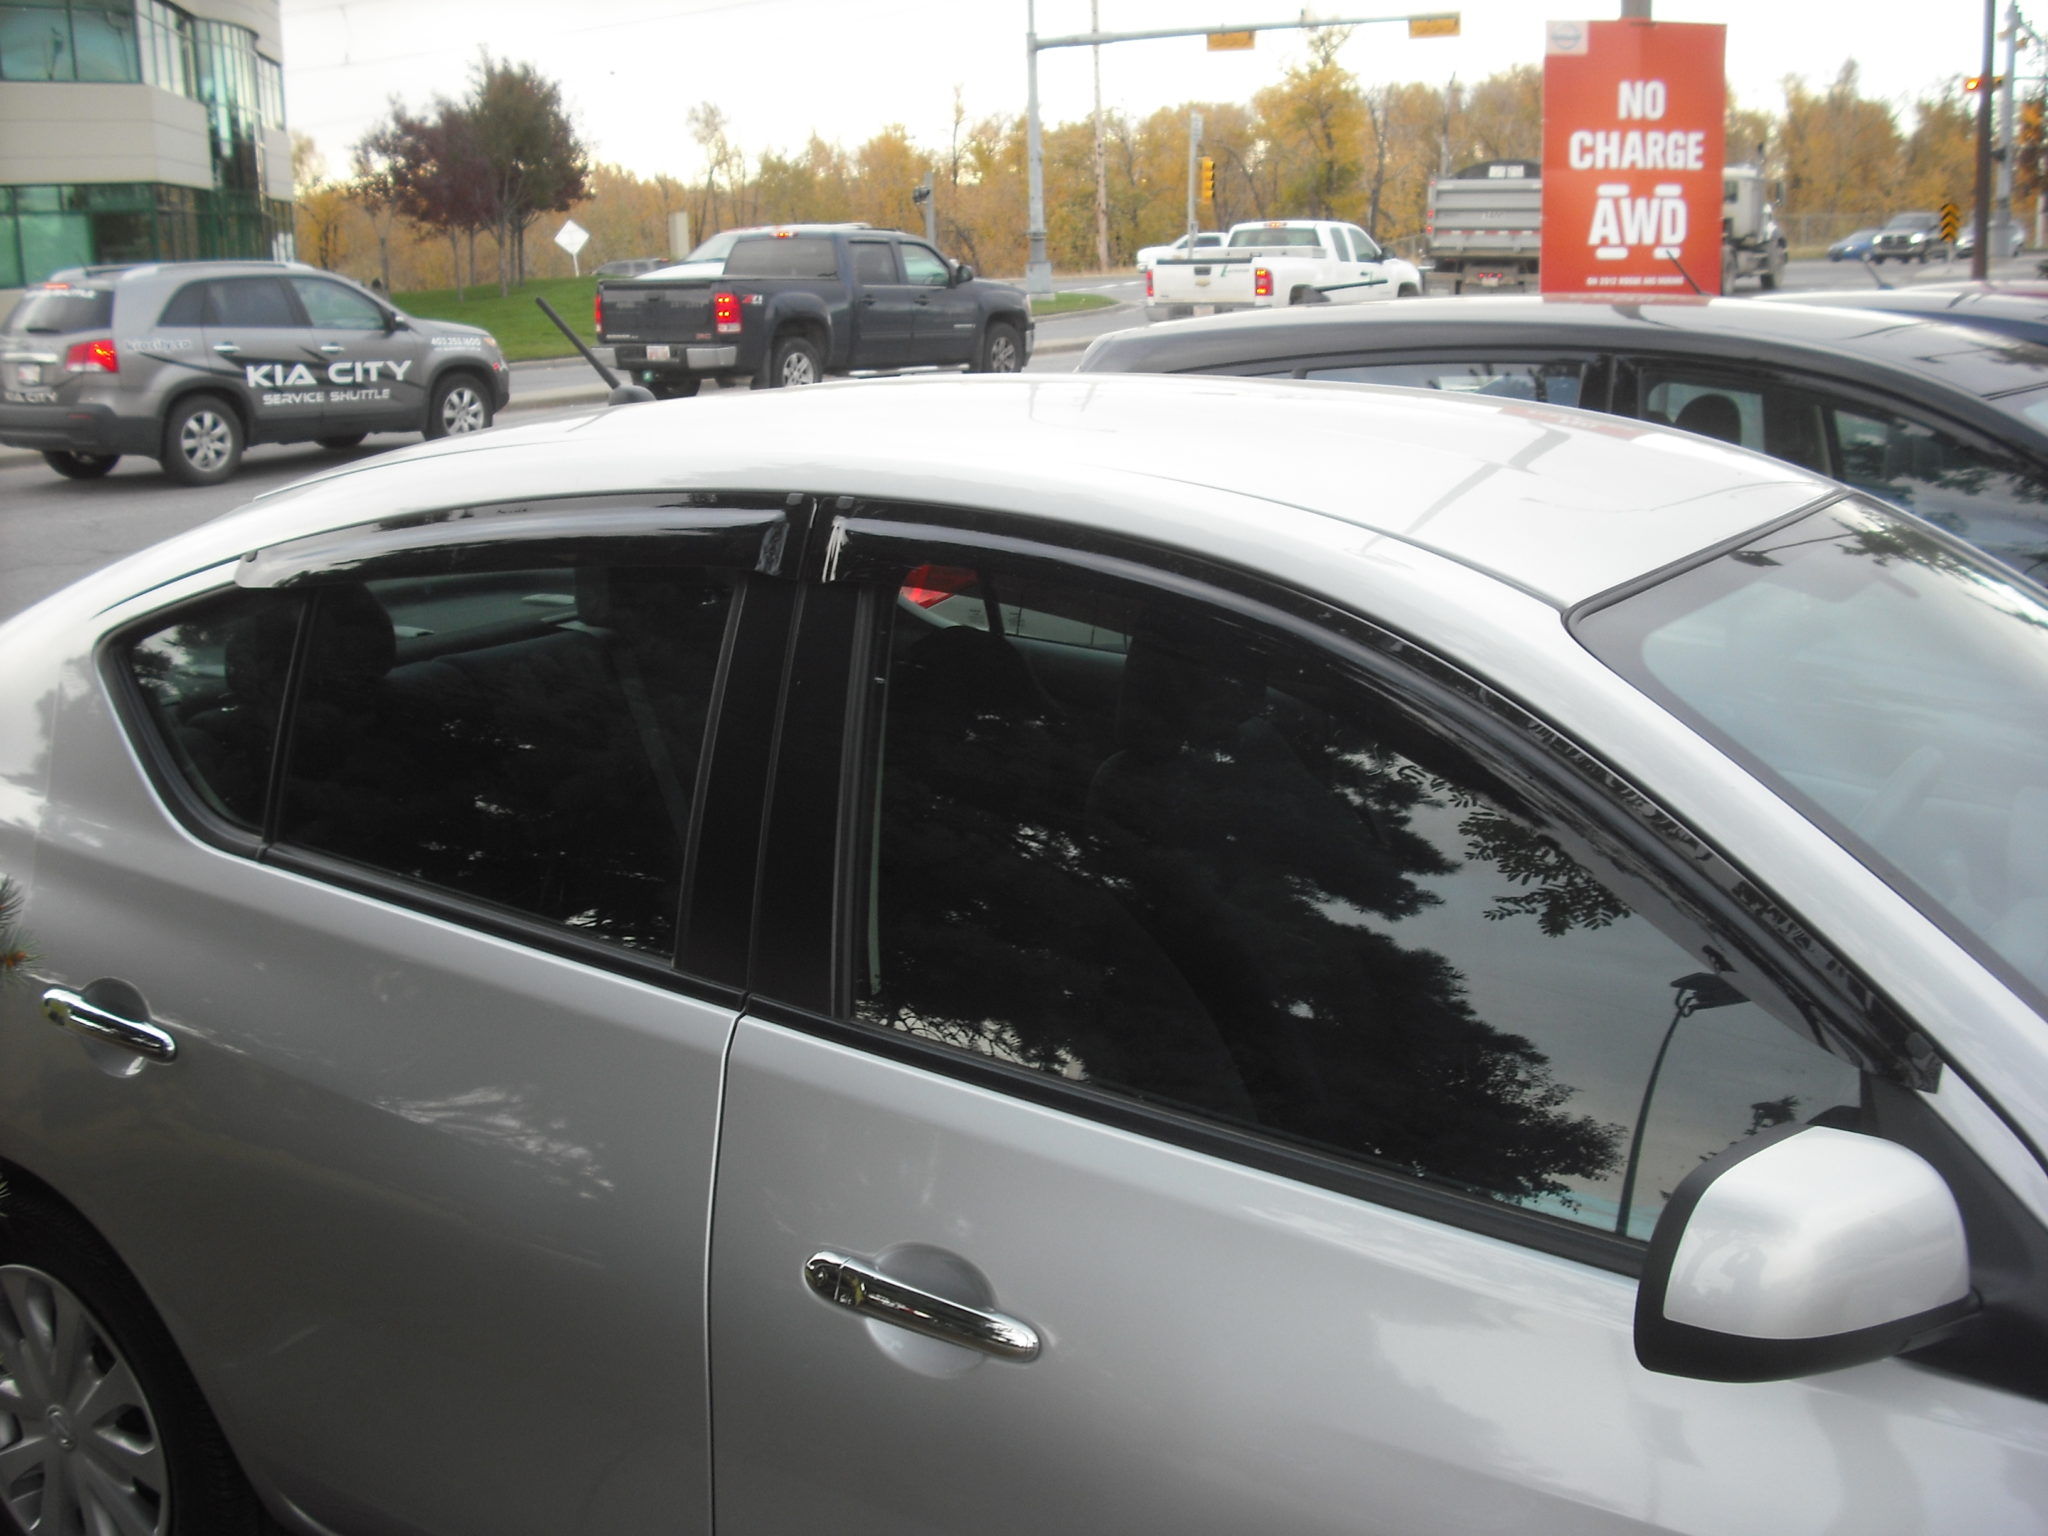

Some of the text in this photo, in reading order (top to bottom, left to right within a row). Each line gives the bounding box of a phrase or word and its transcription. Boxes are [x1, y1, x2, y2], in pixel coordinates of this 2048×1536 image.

[1617, 80, 1666, 121] NO
[1568, 130, 1705, 171] CHARGE
[1587, 196, 1688, 246] AWD
[246, 360, 413, 388] KIA CITY
[262, 388, 391, 405] SERVICE SHUTTLE
